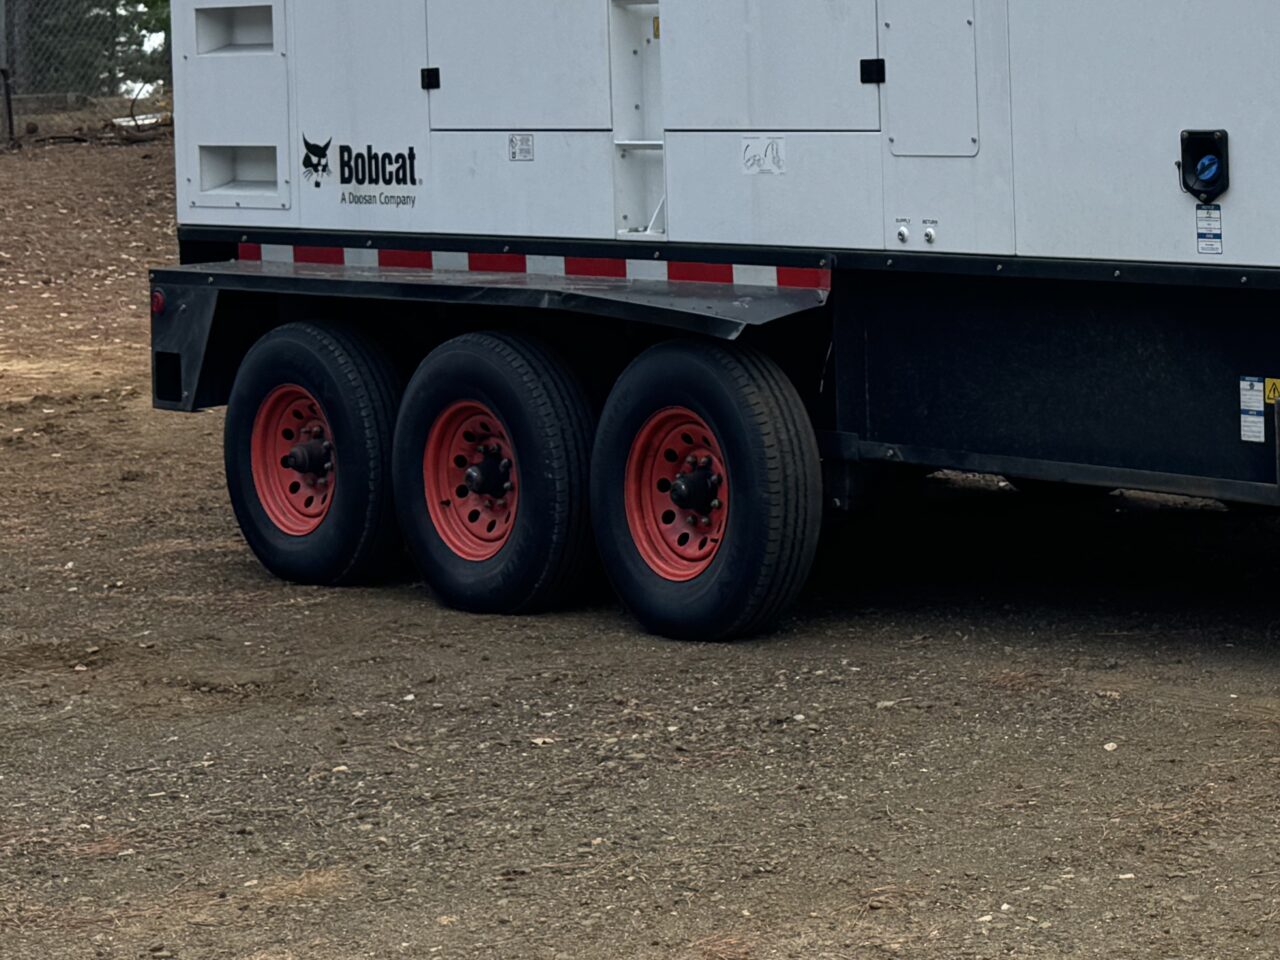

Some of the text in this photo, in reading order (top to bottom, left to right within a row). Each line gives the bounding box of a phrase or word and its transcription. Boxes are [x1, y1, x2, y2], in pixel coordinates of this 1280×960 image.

[339, 144, 417, 186] Bobcat
[340, 192, 416, 208] A Doosan Company
